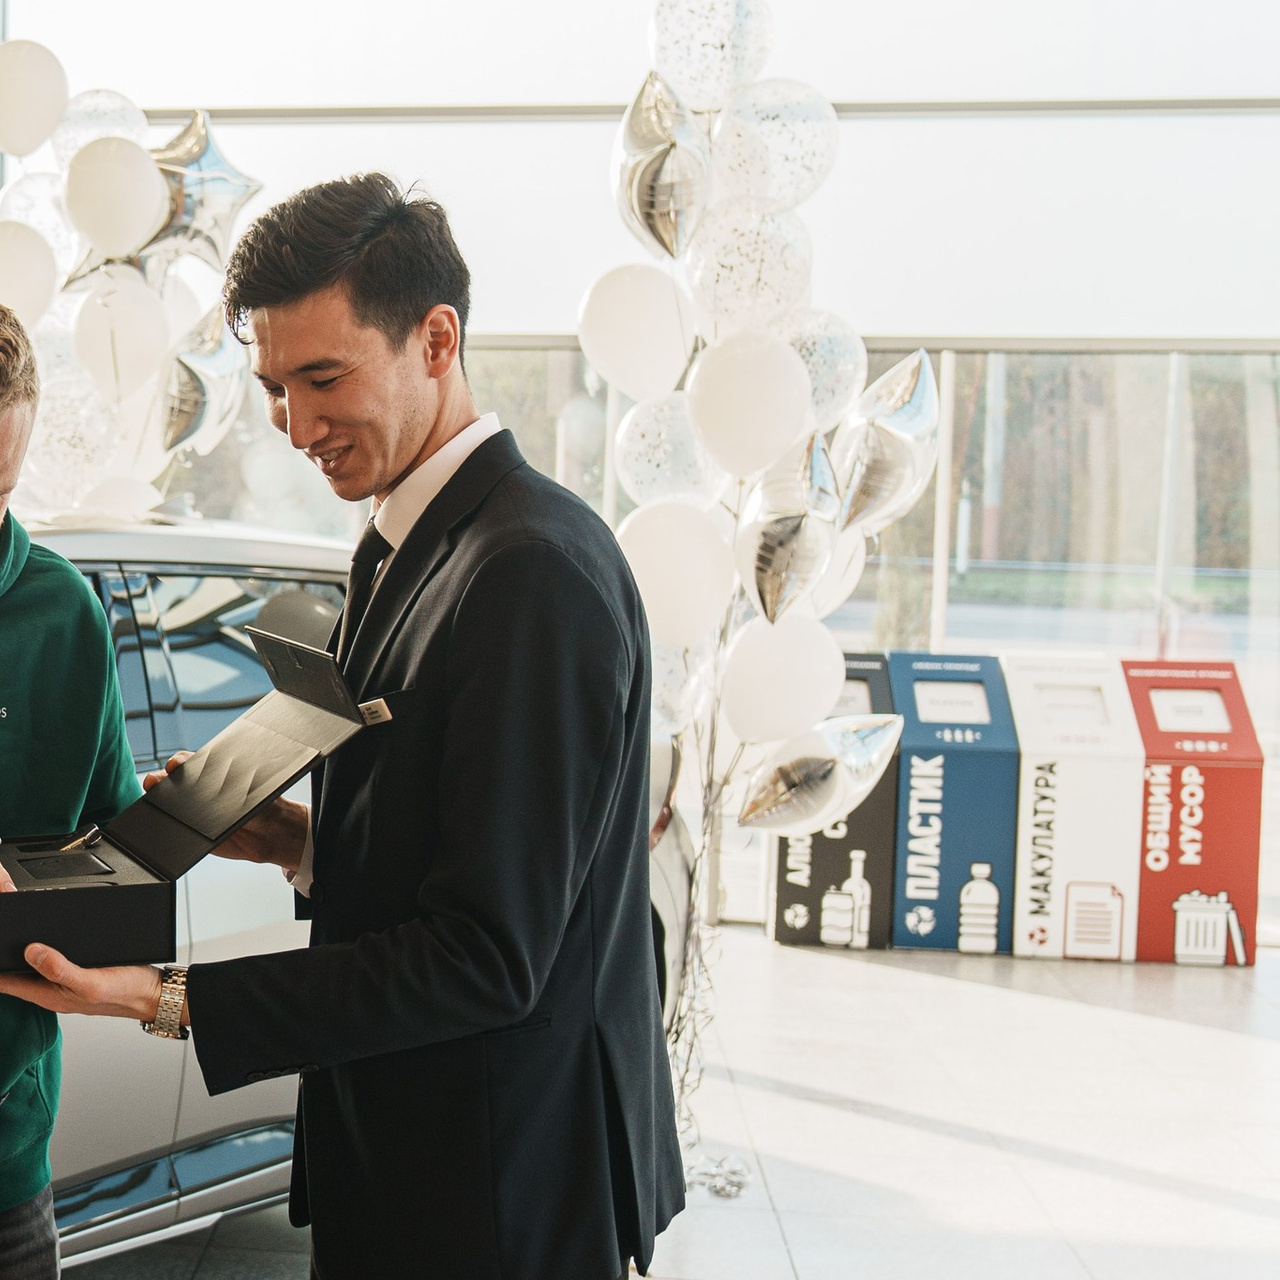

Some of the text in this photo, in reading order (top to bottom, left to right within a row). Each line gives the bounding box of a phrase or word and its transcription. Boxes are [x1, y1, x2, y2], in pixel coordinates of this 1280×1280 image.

[905, 754, 944, 900] ПЛАСТИК
[1029, 761, 1057, 916] МАКУЛАТУРА
[1144, 764, 1173, 872] ОБЩИЙ
[1178, 765, 1205, 865] МУСОР
